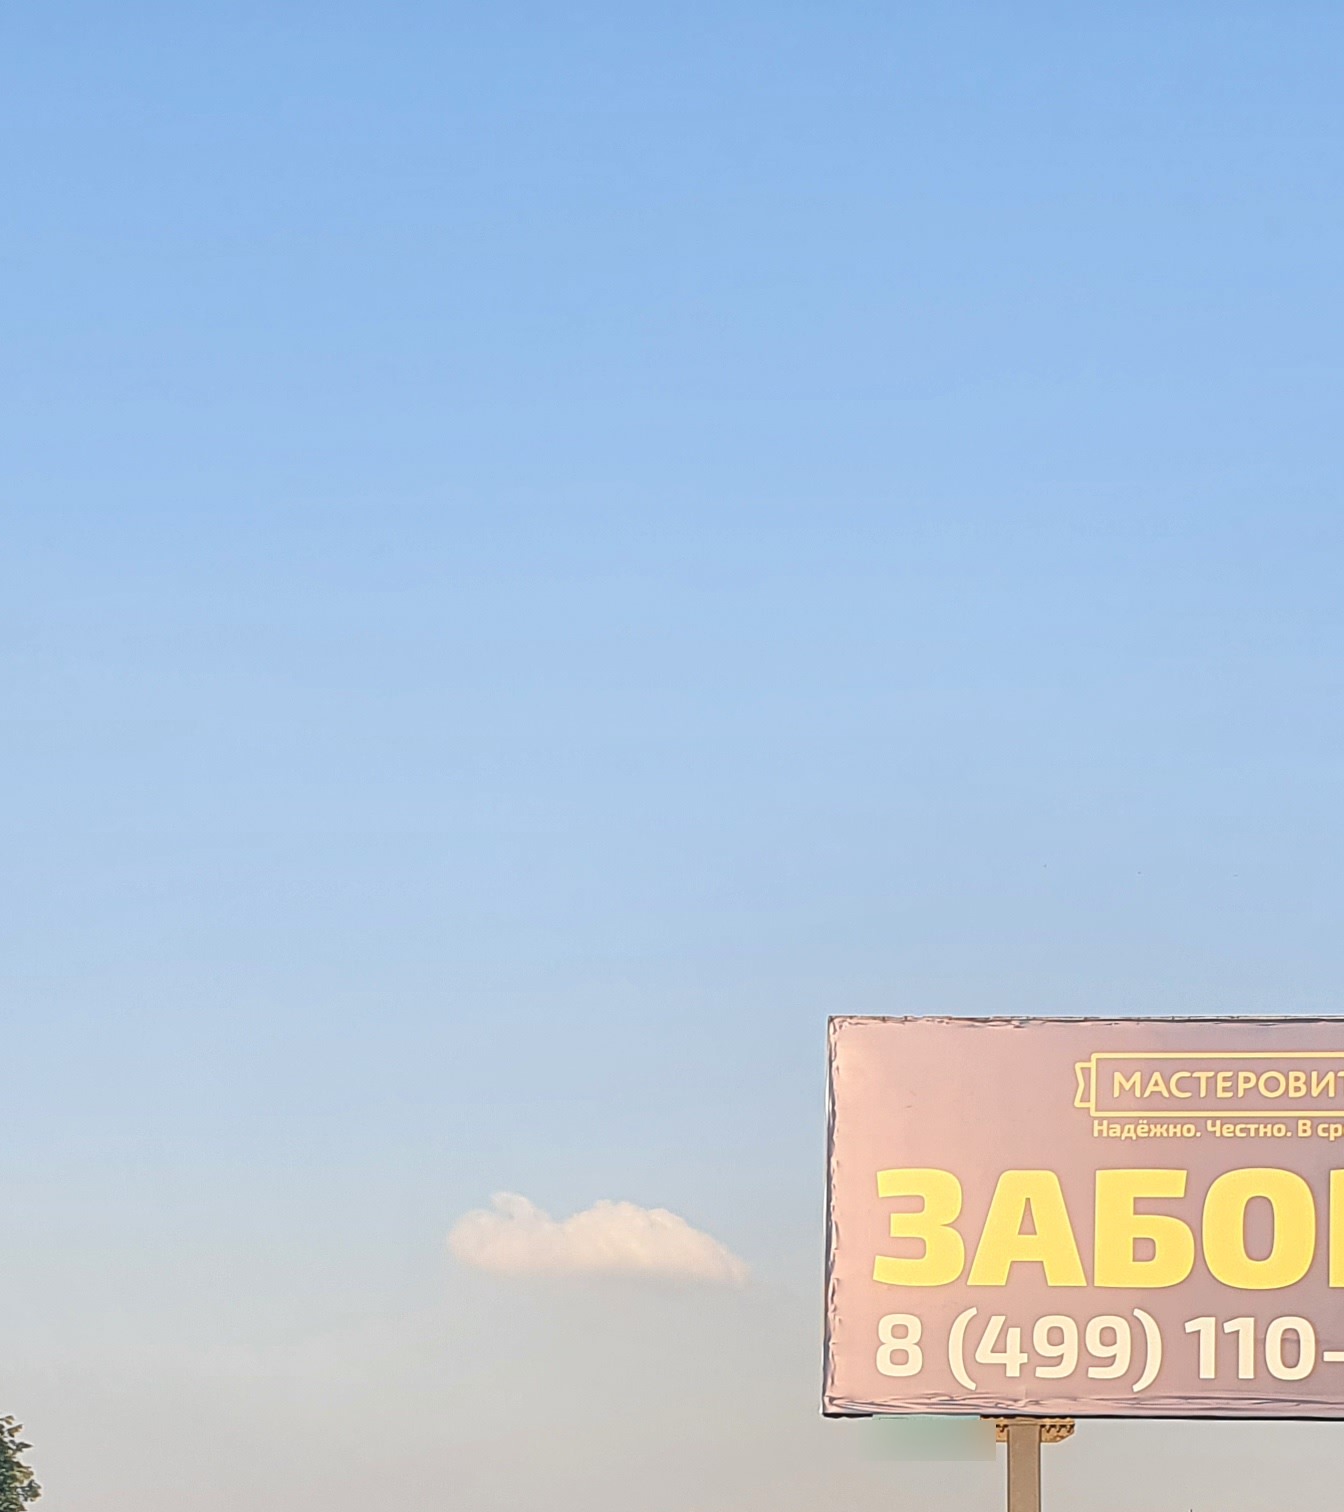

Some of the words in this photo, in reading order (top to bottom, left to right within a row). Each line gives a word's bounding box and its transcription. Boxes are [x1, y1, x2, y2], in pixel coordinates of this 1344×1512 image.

[1092, 1119, 1202, 1140] Надёжно.
[1206, 1119, 1292, 1137] Честно.
[1297, 1119, 1312, 1137] В
[875, 1313, 923, 1378] 8
[947, 1306, 1164, 1391] (499)
